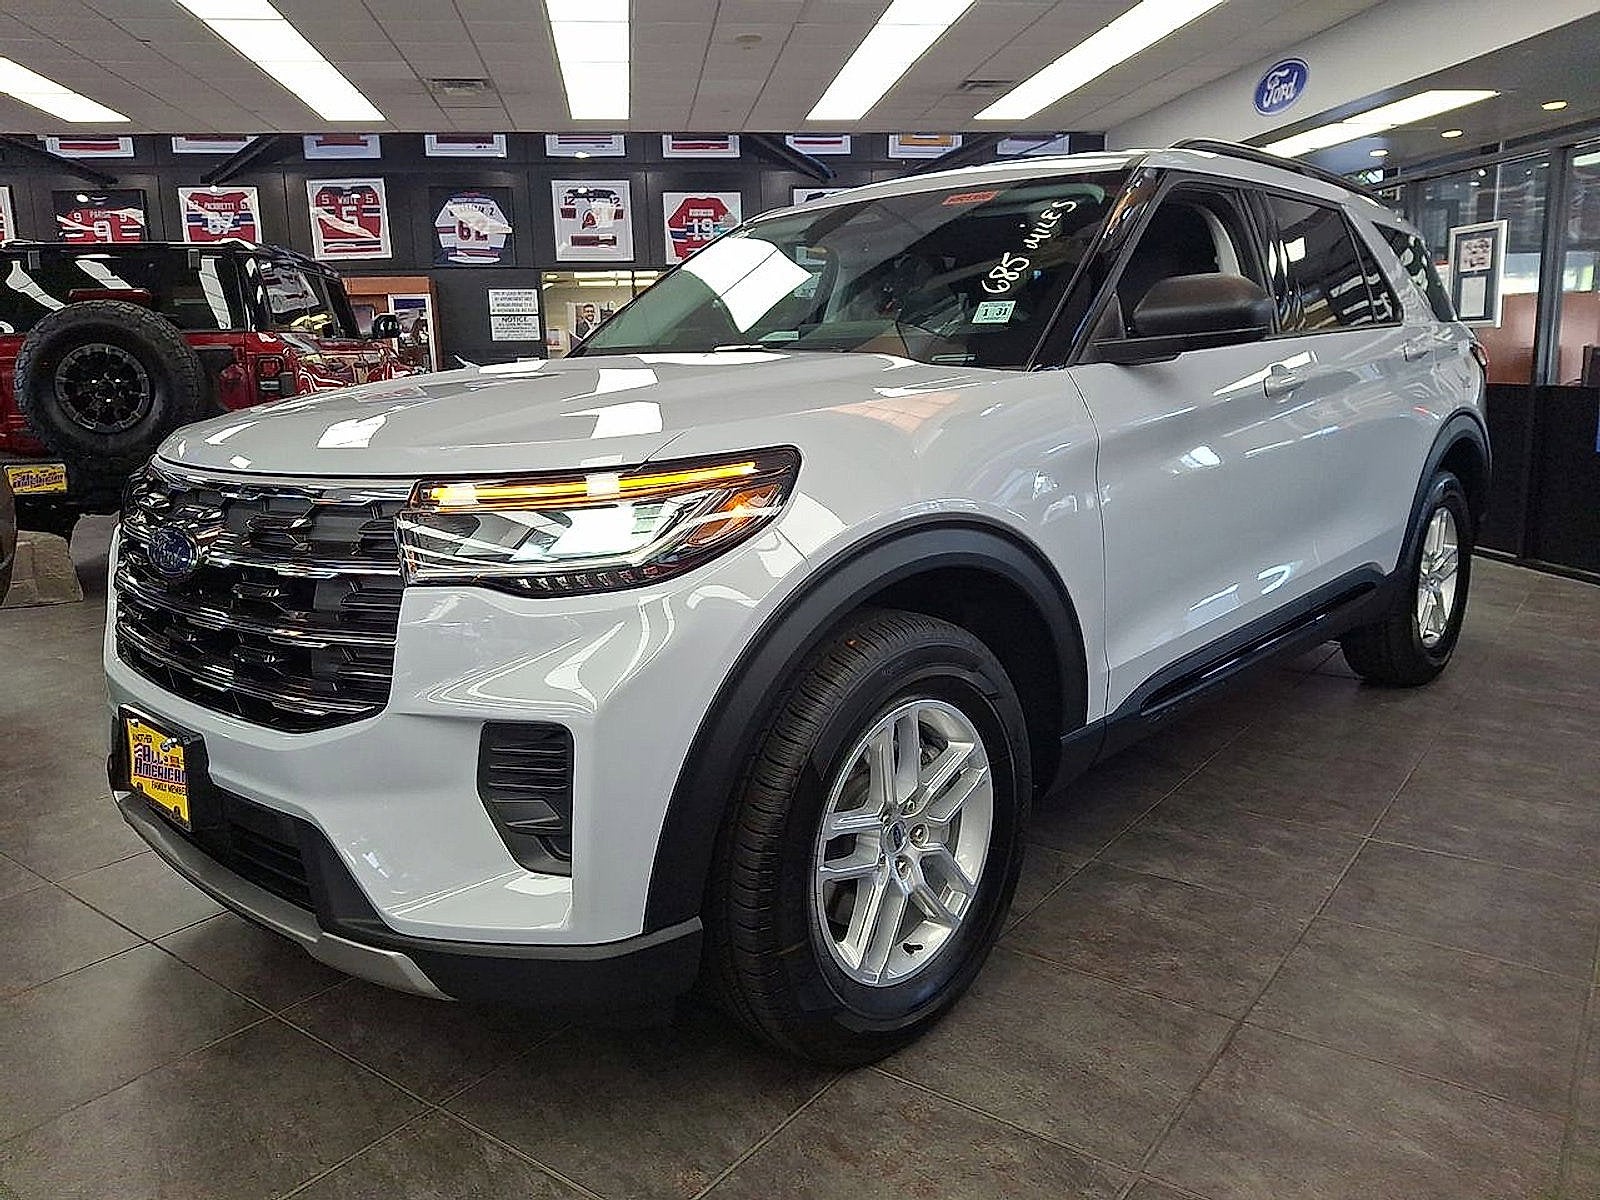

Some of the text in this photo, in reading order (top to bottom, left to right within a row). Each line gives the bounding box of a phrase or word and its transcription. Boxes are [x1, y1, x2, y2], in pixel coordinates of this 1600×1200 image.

[1263, 69, 1298, 108] Ford
[564, 196, 576, 206] 12
[74, 211, 83, 223] 9
[692, 218, 715, 240] 19
[981, 252, 1030, 294] 685
[142, 744, 164, 765] ALL
